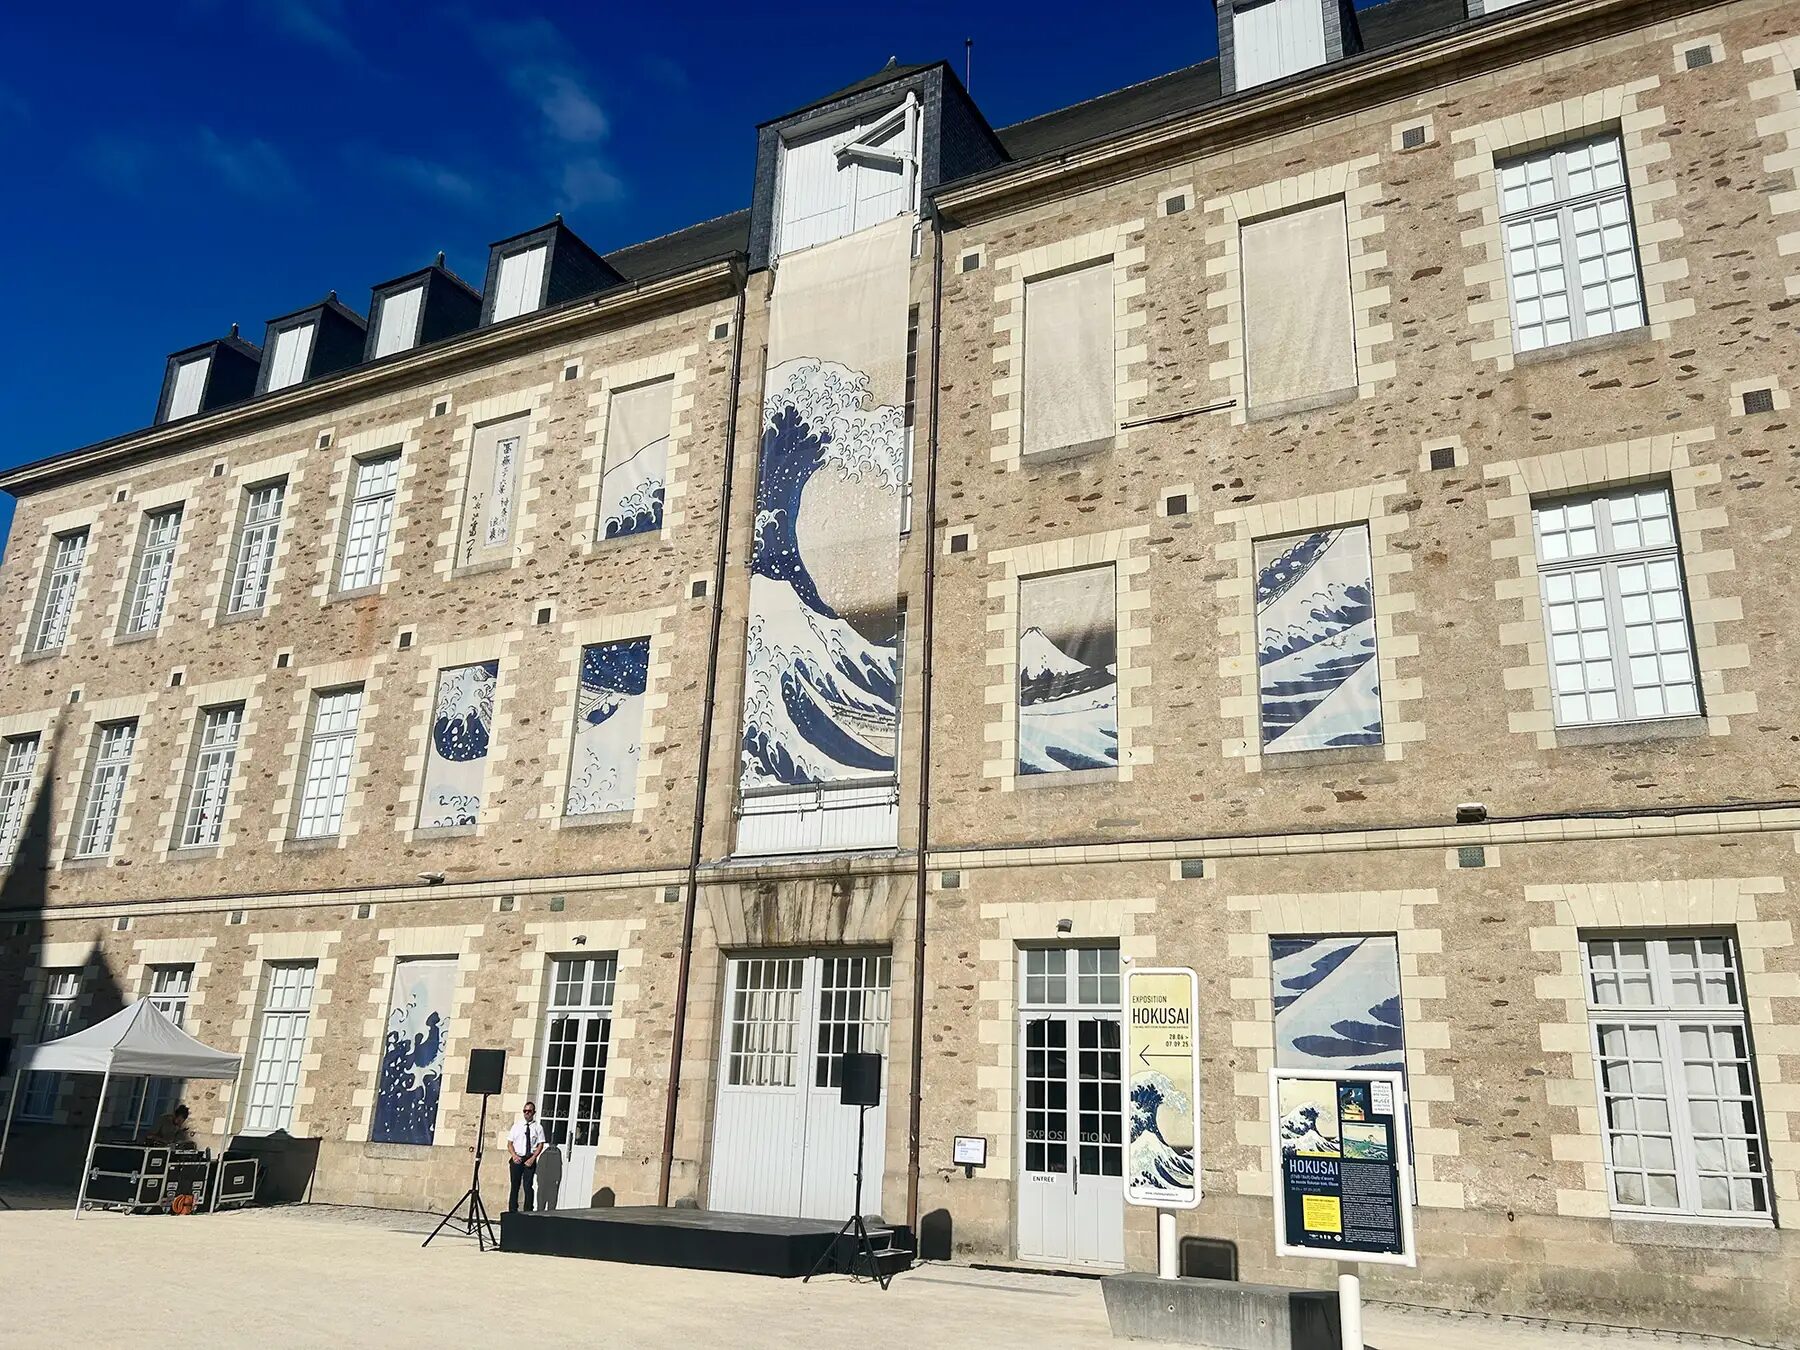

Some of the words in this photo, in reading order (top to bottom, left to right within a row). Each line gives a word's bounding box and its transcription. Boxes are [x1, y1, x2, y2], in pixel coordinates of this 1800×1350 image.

[1132, 995, 1167, 1004] EXPOSITION
[1132, 1007, 1189, 1025] HOKUSAI
[1027, 1129, 1111, 1142] EXPOSITION
[1289, 1159, 1339, 1175] HOKUSAI
[1032, 1175, 1055, 1183] ENTRÉE
